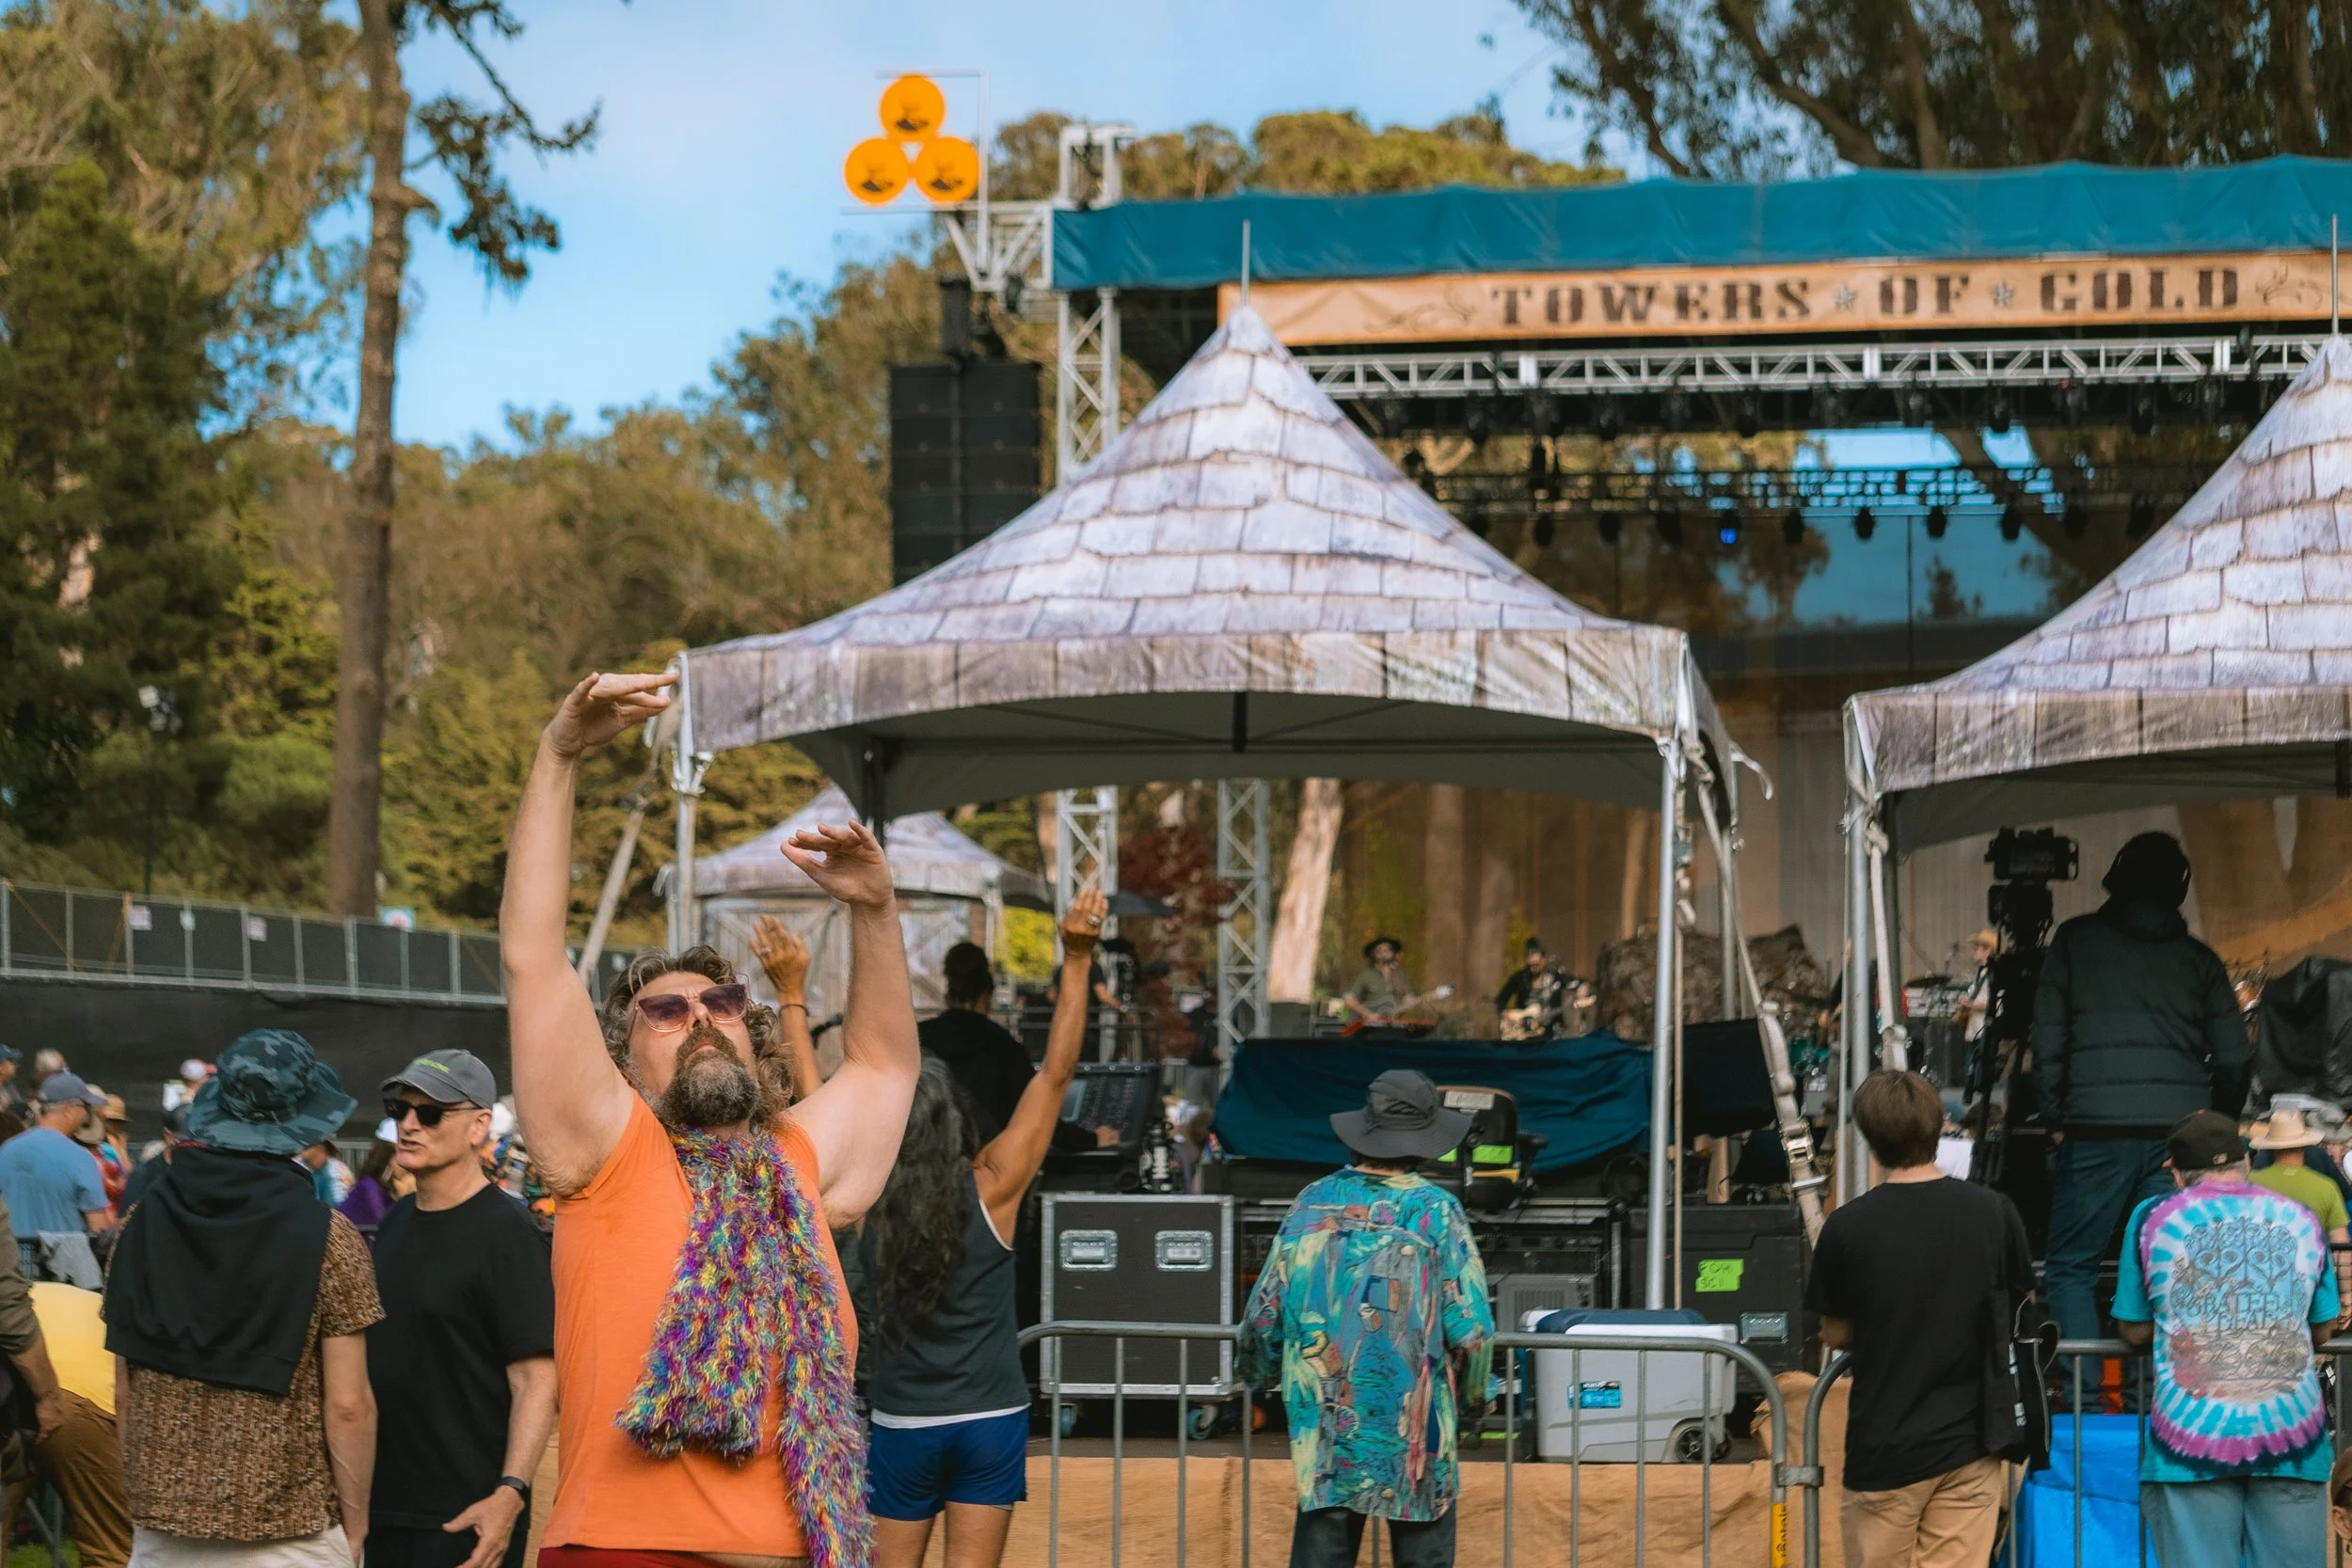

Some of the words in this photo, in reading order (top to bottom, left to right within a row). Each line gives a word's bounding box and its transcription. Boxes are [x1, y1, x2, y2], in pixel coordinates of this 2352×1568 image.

[1490, 279, 1810, 325] TOWERS
[1879, 272, 1969, 315] OF
[2040, 267, 2239, 312] GOLD
